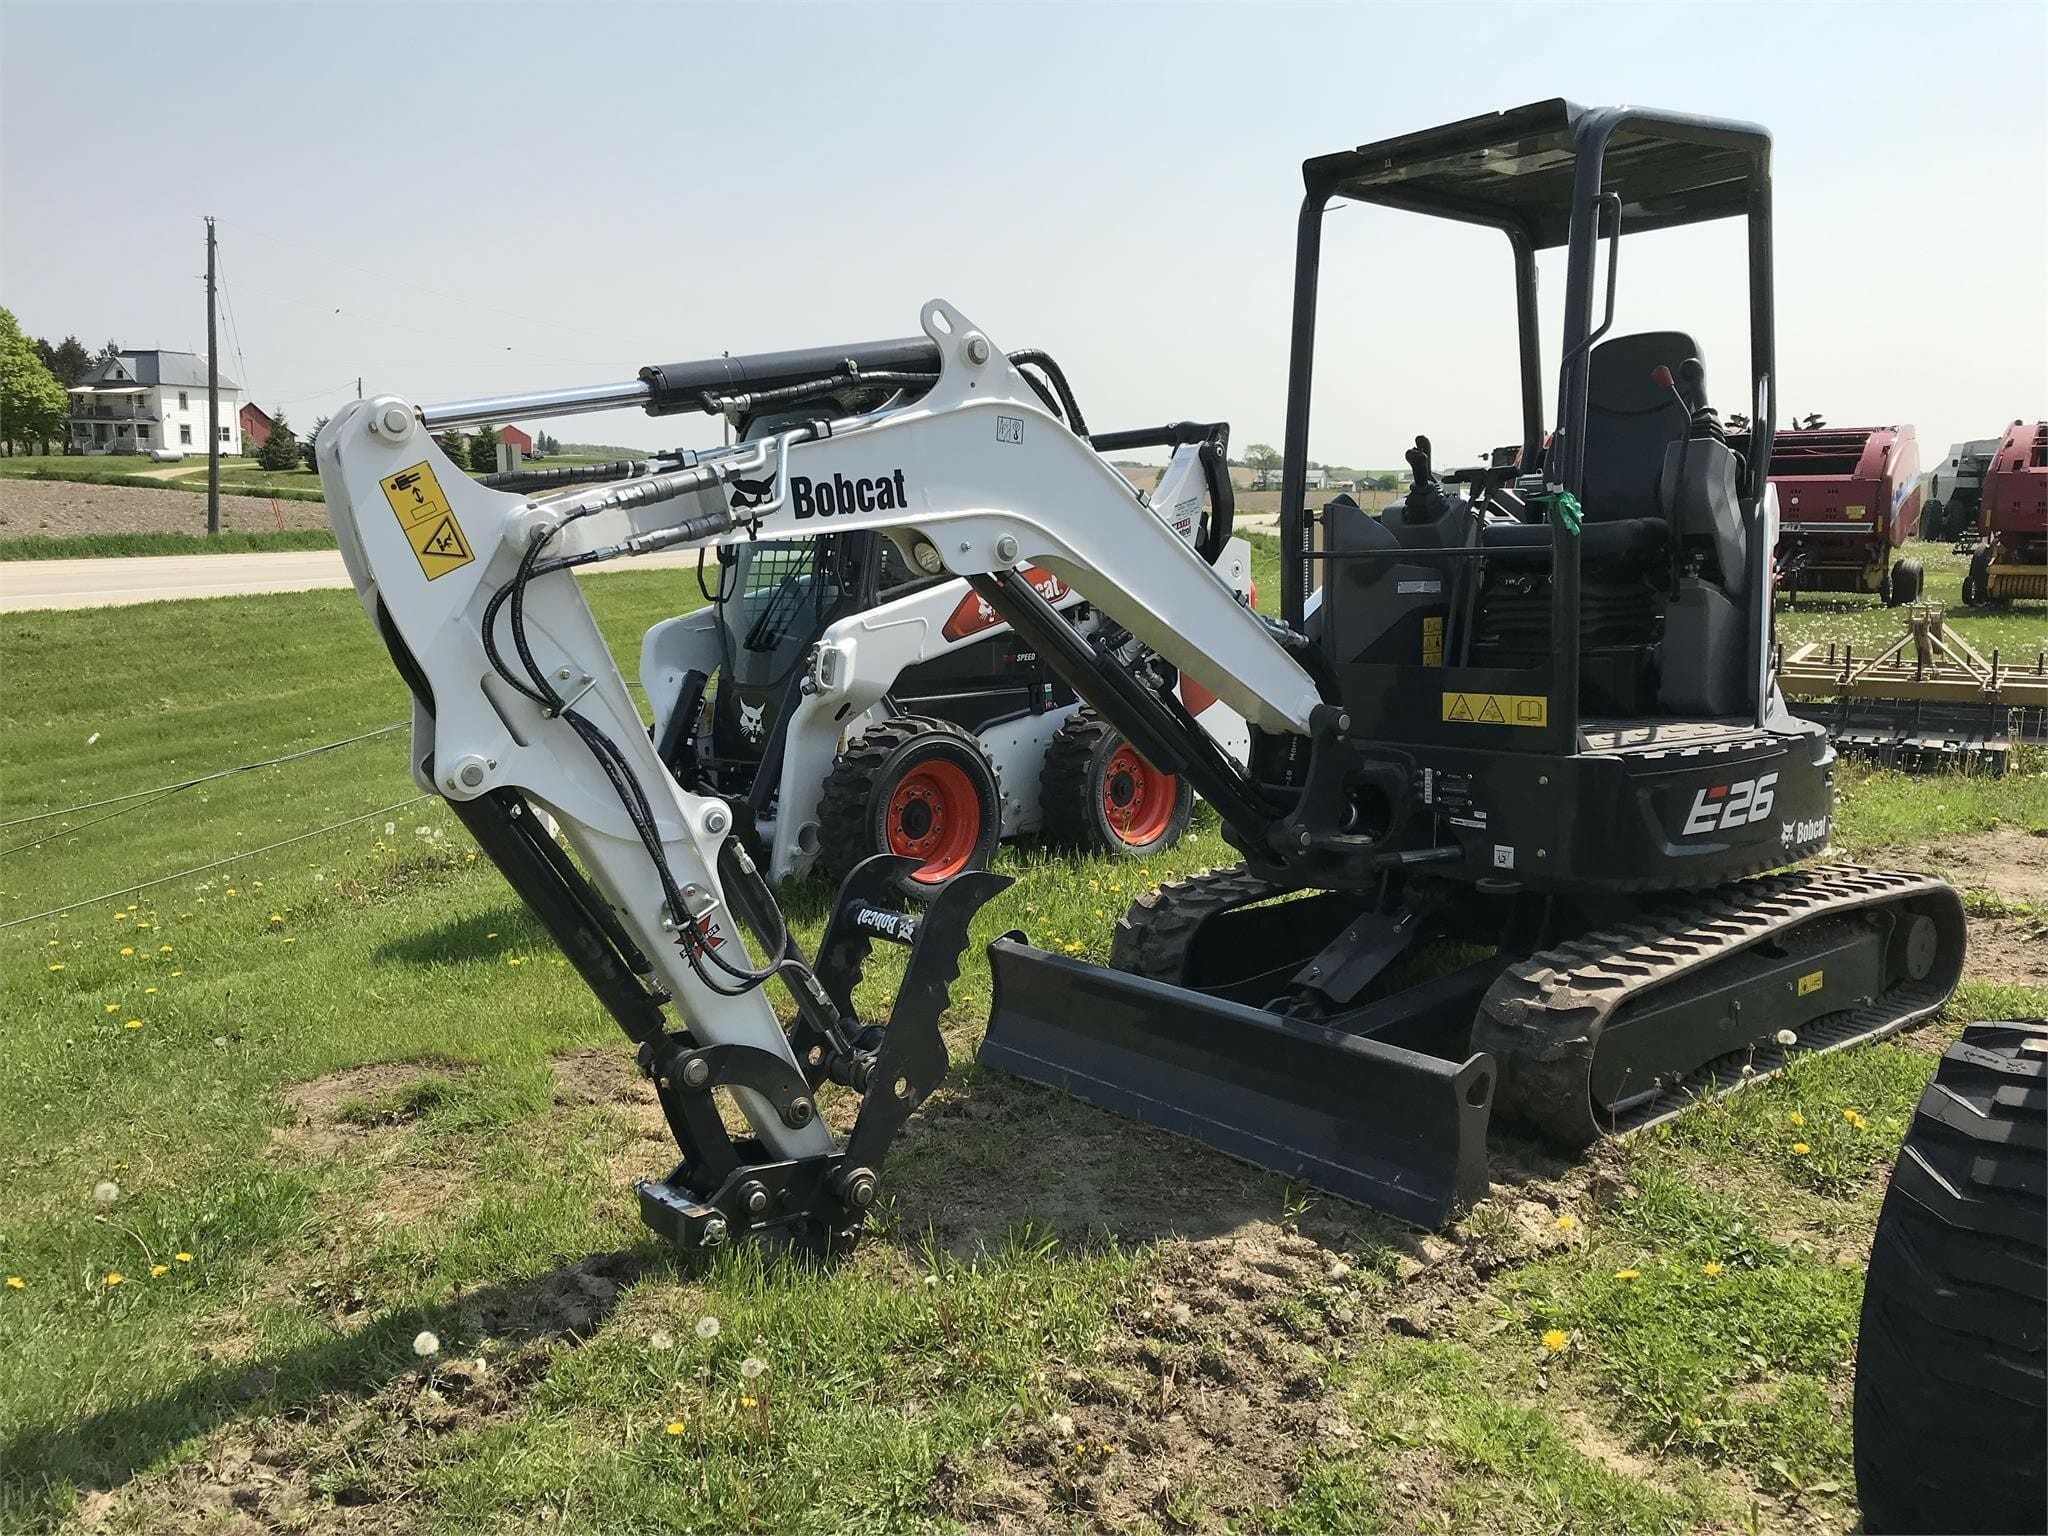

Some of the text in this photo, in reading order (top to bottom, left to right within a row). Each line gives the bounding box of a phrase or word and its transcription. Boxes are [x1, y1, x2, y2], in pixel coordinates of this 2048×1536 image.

[790, 469, 908, 520] Bobcat
[1016, 652, 1036, 662] SPEED
[1682, 772, 1779, 835] E26
[1796, 815, 1827, 845] Bobcat
[857, 908, 899, 935] Bobcat
